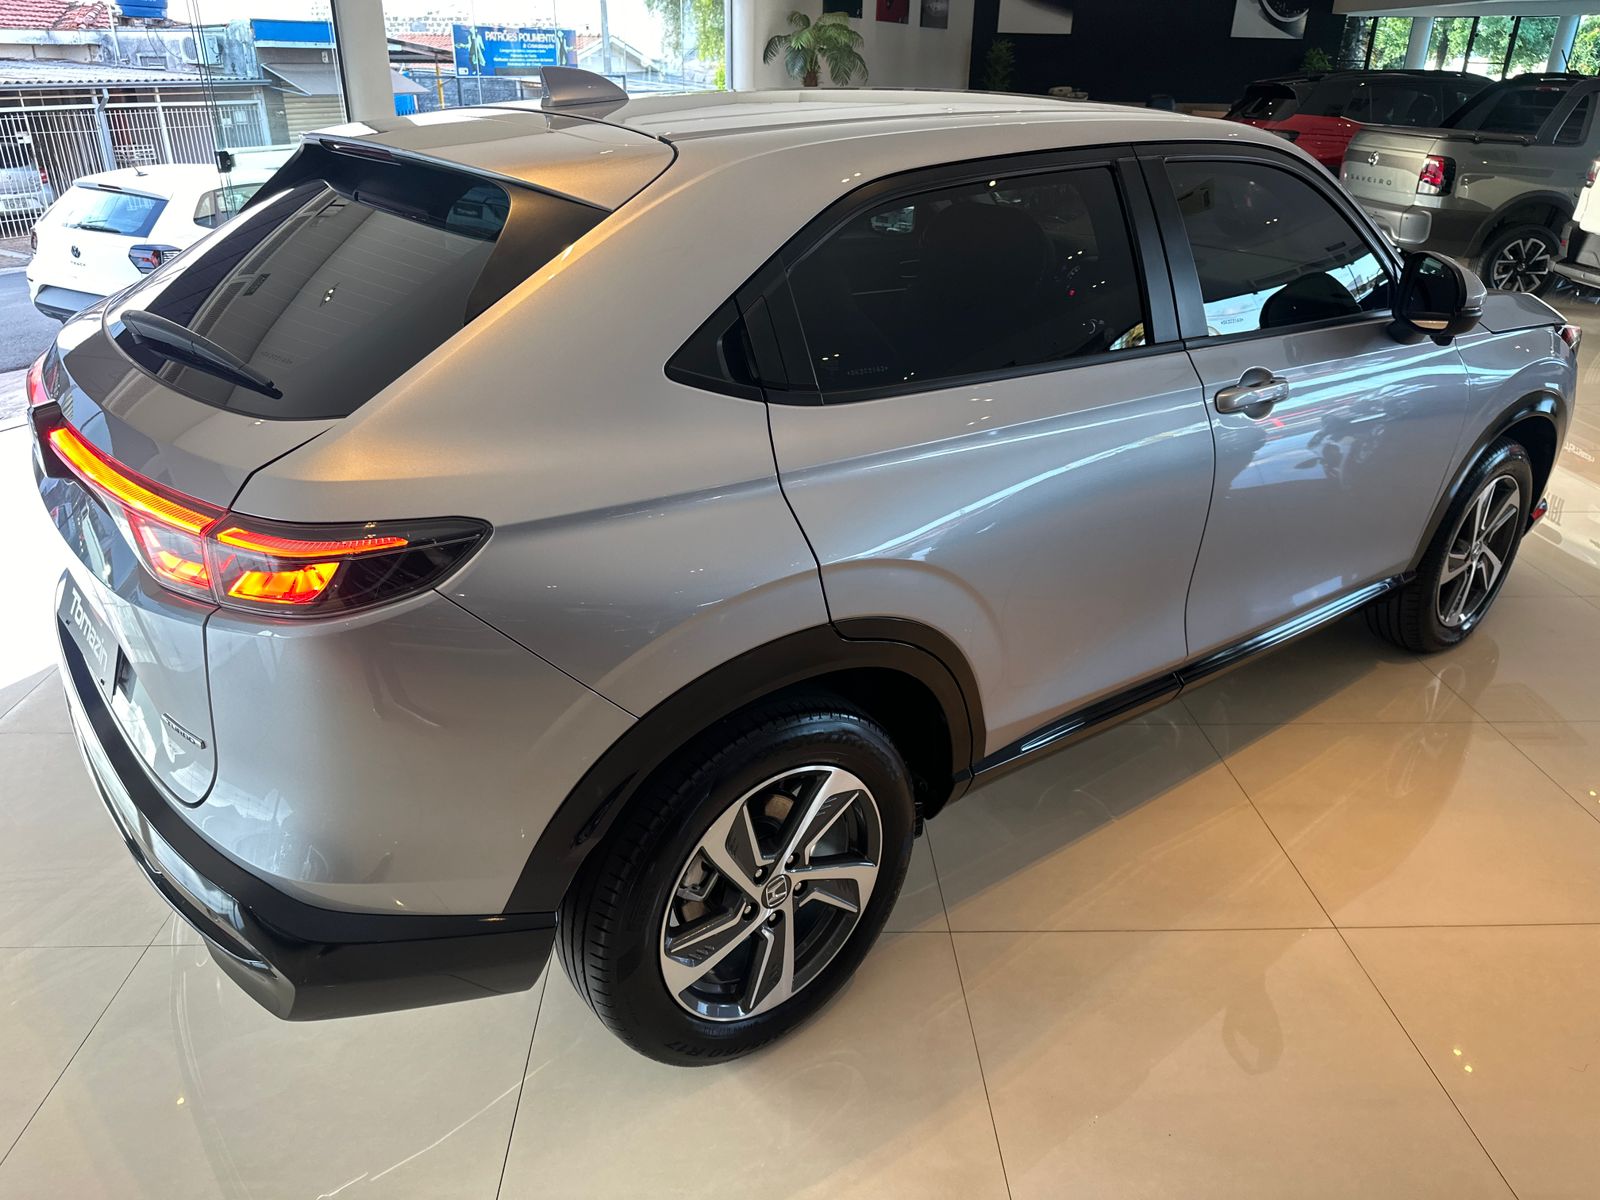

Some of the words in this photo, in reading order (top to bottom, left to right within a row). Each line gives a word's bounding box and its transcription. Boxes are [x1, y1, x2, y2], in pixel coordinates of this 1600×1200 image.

[484, 30, 518, 42] PATRÕES
[1350, 173, 1392, 186] SAVEIRO
[70, 587, 108, 673] Tomazin
